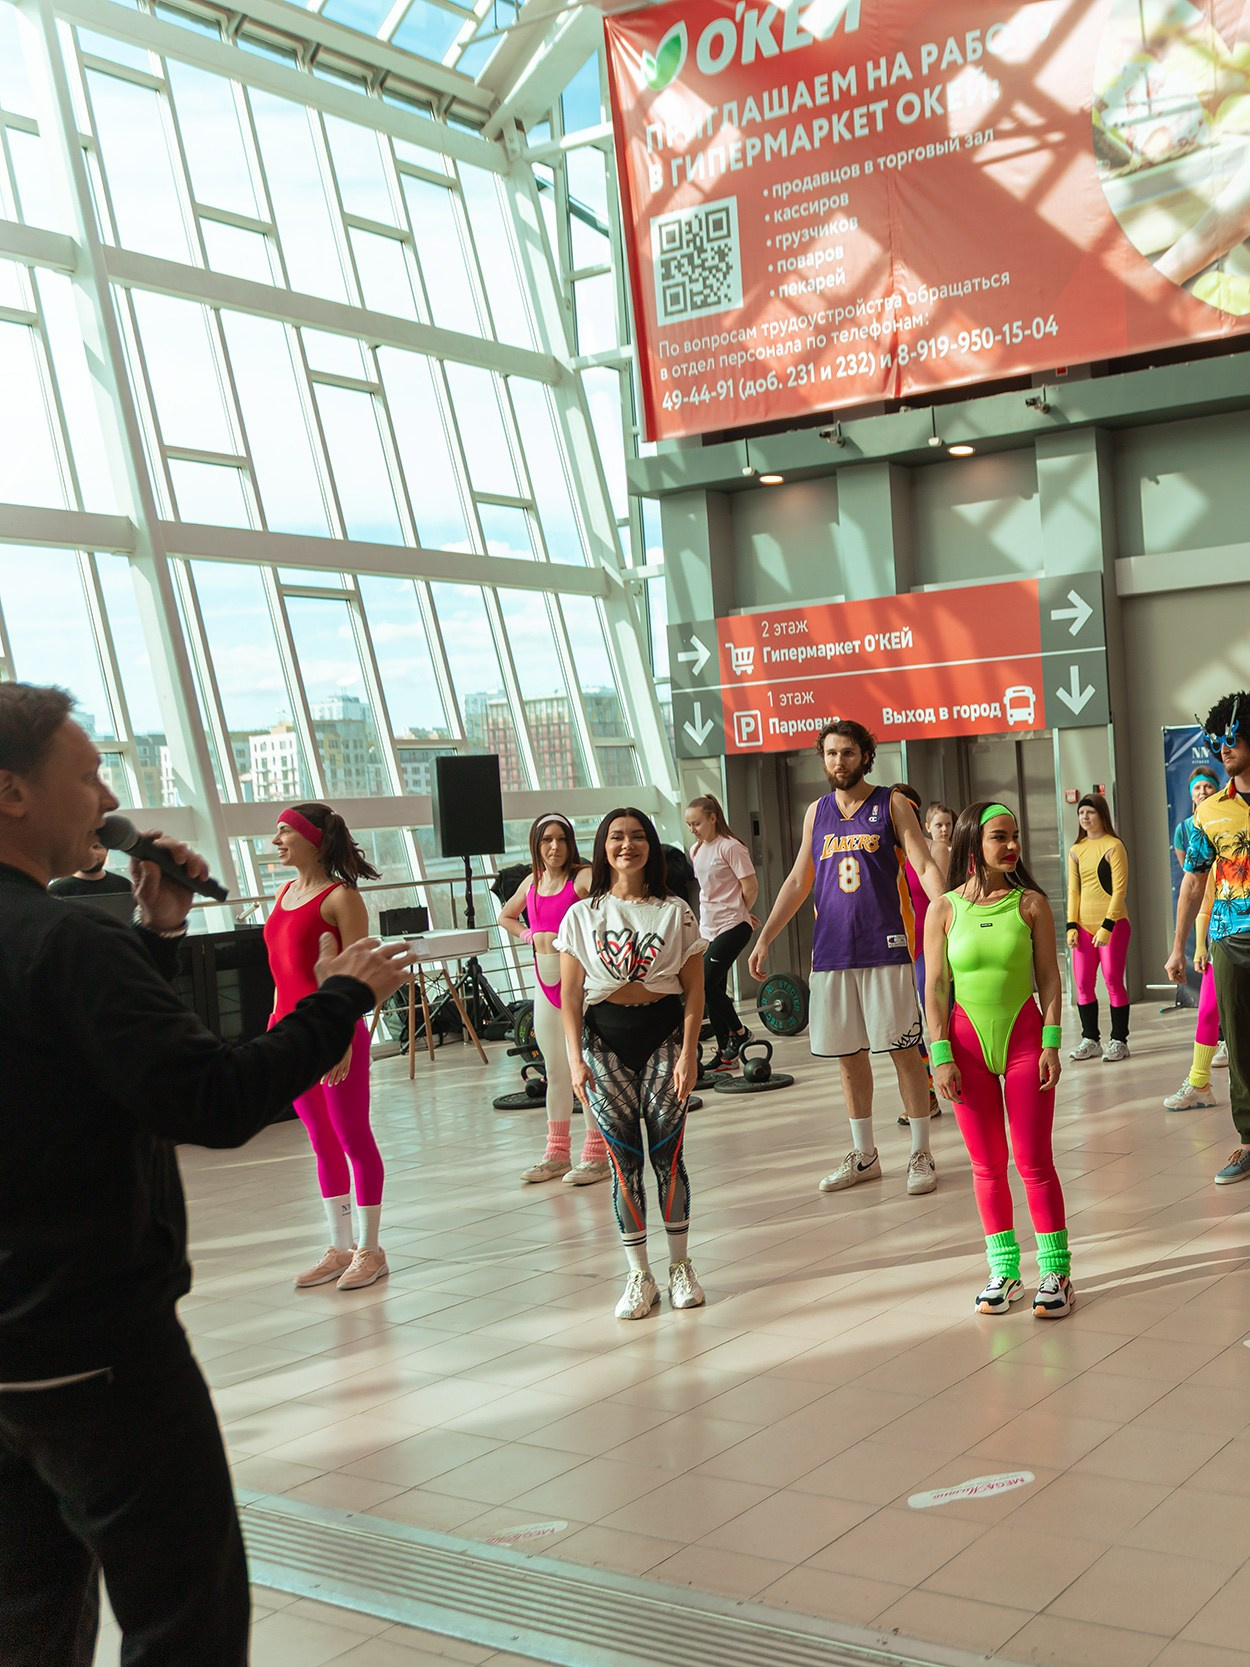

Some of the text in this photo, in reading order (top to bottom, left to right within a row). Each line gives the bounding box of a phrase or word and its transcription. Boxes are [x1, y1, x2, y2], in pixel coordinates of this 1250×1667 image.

[645, 66, 857, 154] ПИГЛАШАЕМ
[866, 51, 913, 92] НА
[648, 160, 664, 194] В
[670, 99, 889, 187] ГИПЕРМАРКЕТ
[772, 128, 995, 200] продавцов в торговый зал
[773, 192, 849, 223] кассиров
[775, 217, 858, 251] грузчиков
[777, 245, 845, 274] поваров
[779, 268, 846, 298] пекарей
[659, 271, 1011, 359] По вопросам трудоустройства обращаться
[660, 312, 930, 380] в отдел персонала по телефонам:
[661, 314, 1060, 412] 49-44-91 (доб. 231 и 232) и 8-919-950-15-04
[761, 619, 809, 638] 2 этаж
[762, 626, 914, 665] Гипермаркет О'КЕЙ
[767, 690, 815, 708] 1 этаж
[882, 701, 1002, 726] Выход в город
[819, 833, 881, 861] LAKERS
[838, 856, 861, 893] 8
